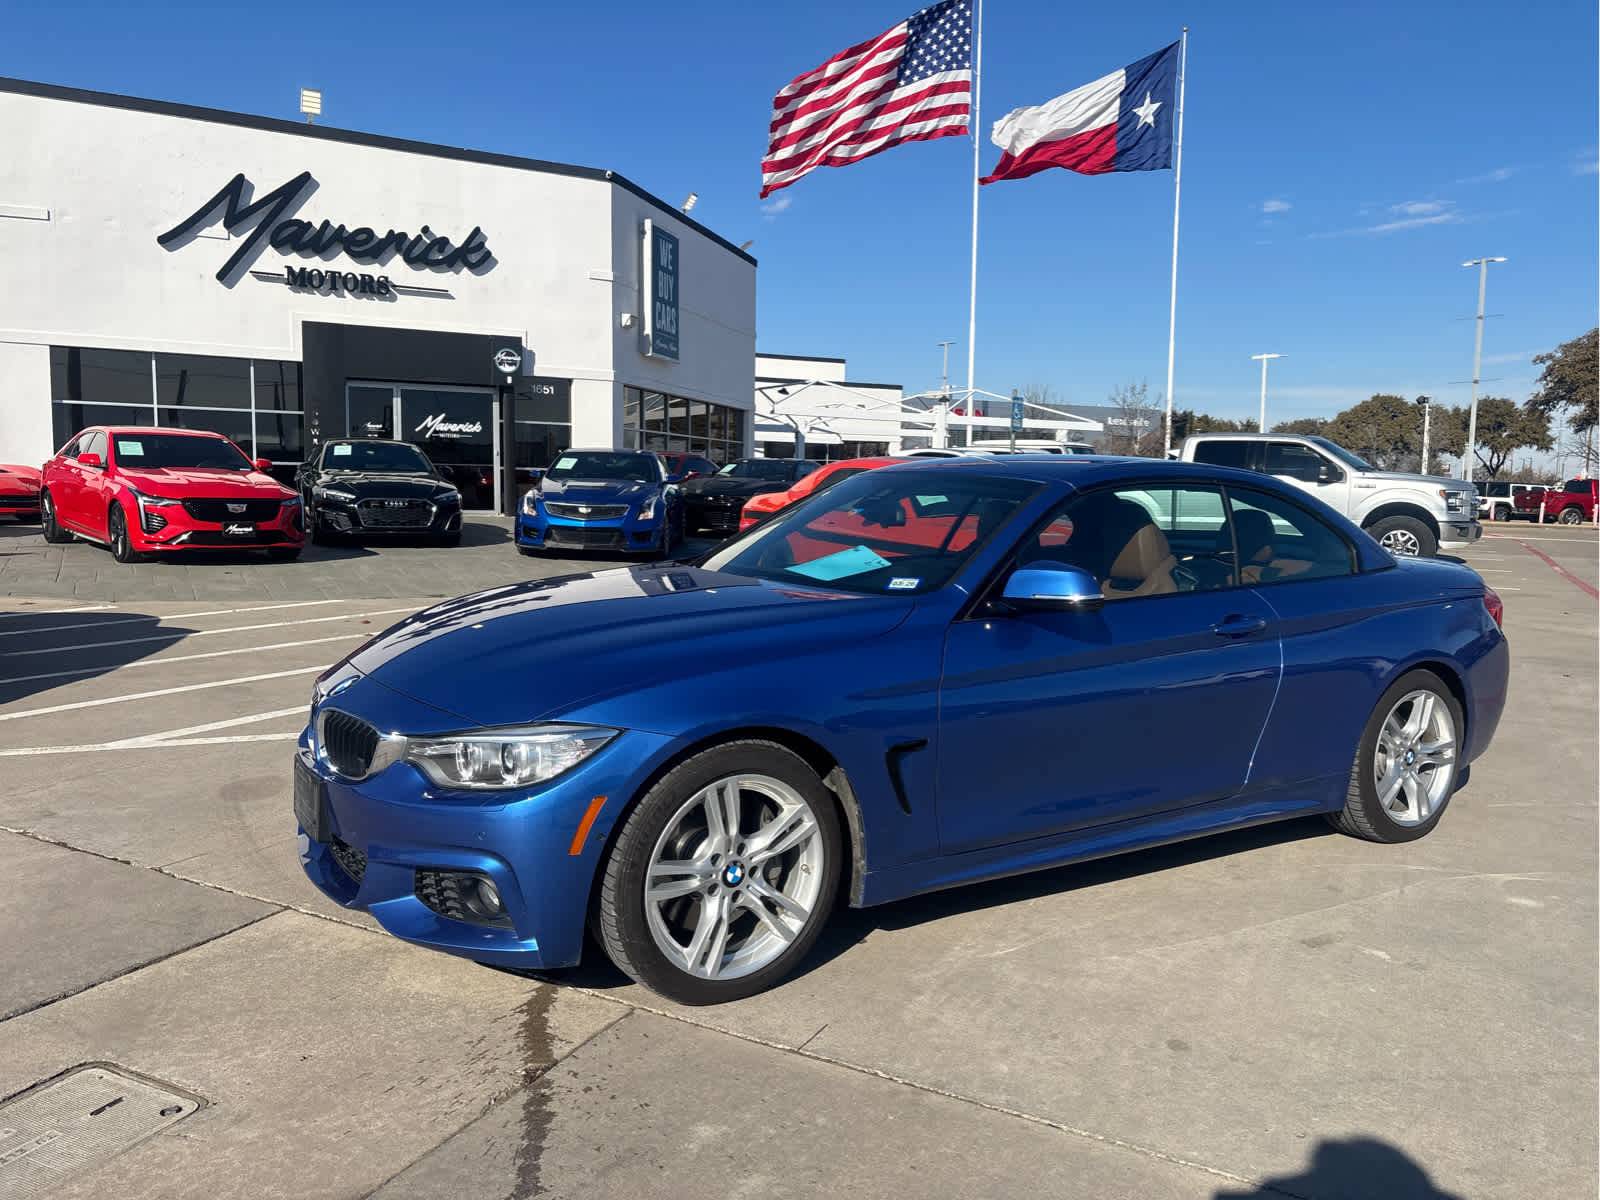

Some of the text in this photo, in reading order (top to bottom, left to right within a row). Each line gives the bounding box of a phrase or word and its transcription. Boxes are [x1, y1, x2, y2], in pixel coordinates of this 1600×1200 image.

[157, 171, 492, 282] Maverick
[659, 238, 673, 270] WE
[284, 265, 390, 296] MOTORS
[658, 269, 675, 302] BUY
[655, 301, 677, 335] CARS
[531, 384, 555, 395] 1651
[414, 412, 482, 439] Maverick
